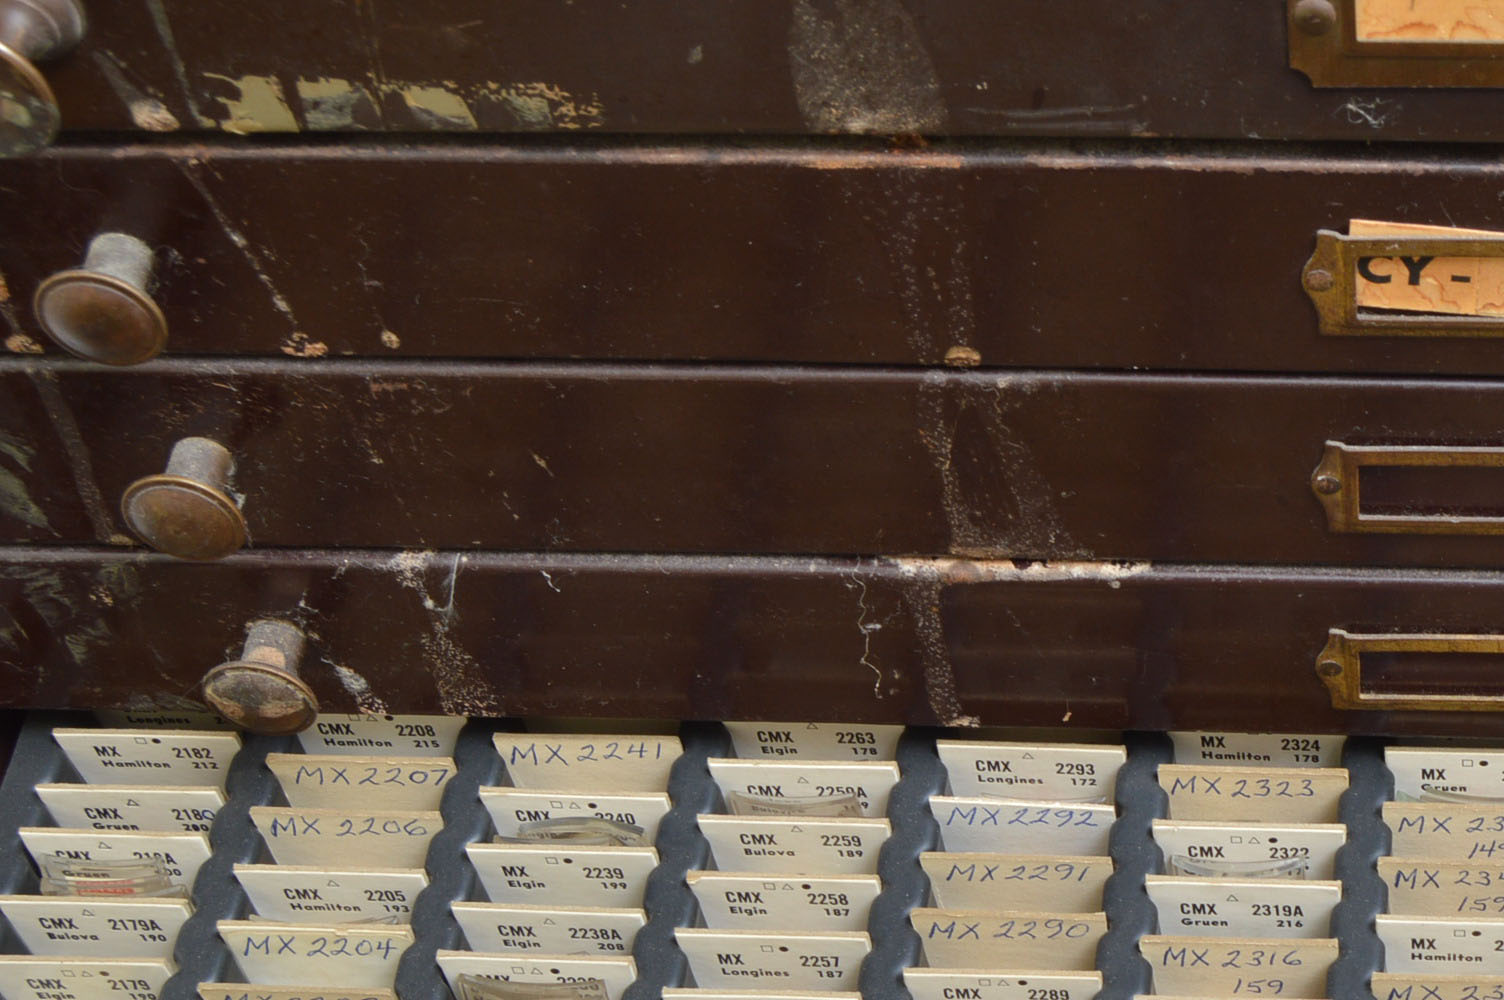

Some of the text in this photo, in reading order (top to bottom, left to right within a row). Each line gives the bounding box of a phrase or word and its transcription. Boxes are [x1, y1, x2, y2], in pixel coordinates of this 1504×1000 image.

[756, 730, 876, 745] CMX 2263
[92, 745, 214, 760] MX 2182
[509, 741, 662, 766] MX 2241
[760, 745, 878, 756] Elgin 178
[101, 759, 220, 770] Hamilton 212
[975, 759, 1096, 776] CMX 2293
[295, 765, 452, 789] MX 2207
[977, 774, 1098, 787] Longines 172
[945, 806, 1000, 827] MX
[501, 865, 625, 880] MX 2239
[507, 879, 628, 890] Elgin 199
[283, 888, 407, 903] CMX 2205
[289, 902, 411, 914] Hamilton 193
[1179, 902, 1304, 917] CMX 2319A
[1180, 917, 1304, 928] Gruen 216
[1410, 937, 1437, 950] MX
[1162, 946, 1303, 969] MX 2316
[1410, 952, 1483, 963] Hamilton
[943, 987, 982, 1000] CMX
[1233, 977, 1285, 995] 159
